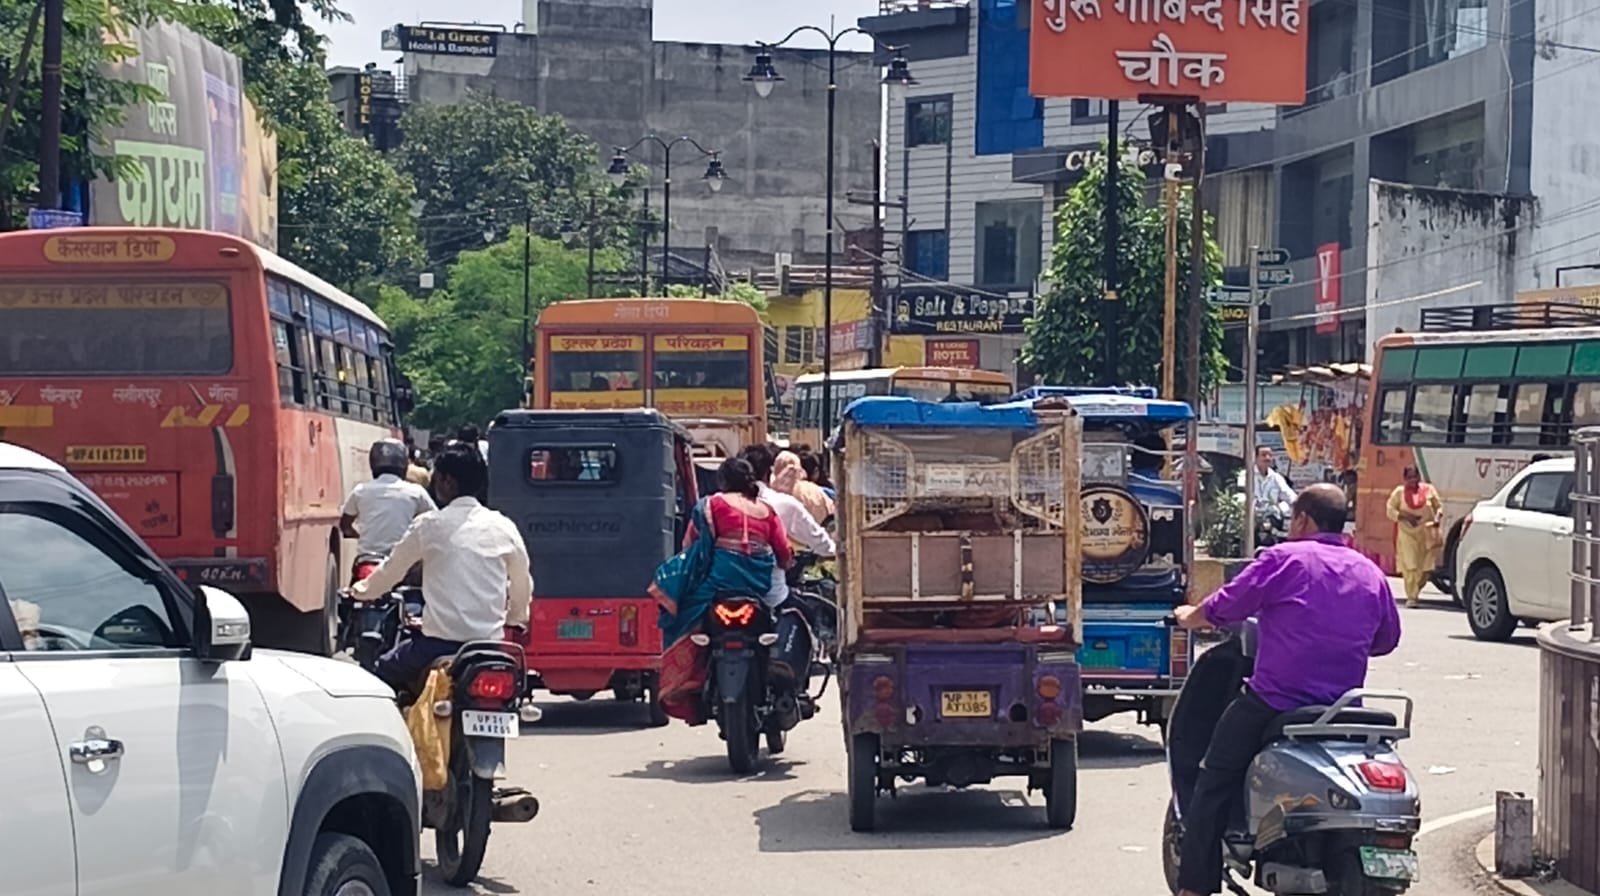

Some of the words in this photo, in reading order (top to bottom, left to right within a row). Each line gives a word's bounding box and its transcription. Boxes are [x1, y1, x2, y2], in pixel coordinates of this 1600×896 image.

[429, 30, 445, 42] La
[448, 31, 491, 44] Grace
[408, 41, 437, 51] Hotel
[448, 42, 493, 55] Banquet
[1114, 33, 1228, 88] चौक
[360, 75, 372, 124] HOTEL
[114, 140, 205, 230] कायम
[914, 295, 946, 316] Salt
[952, 295, 966, 315] &
[969, 295, 1027, 319] Pepper
[936, 321, 1003, 332] RESTAURANT
[666, 336, 724, 350] परिवहन
[933, 350, 970, 360] HOTEL
[528, 519, 621, 532] mahindra
